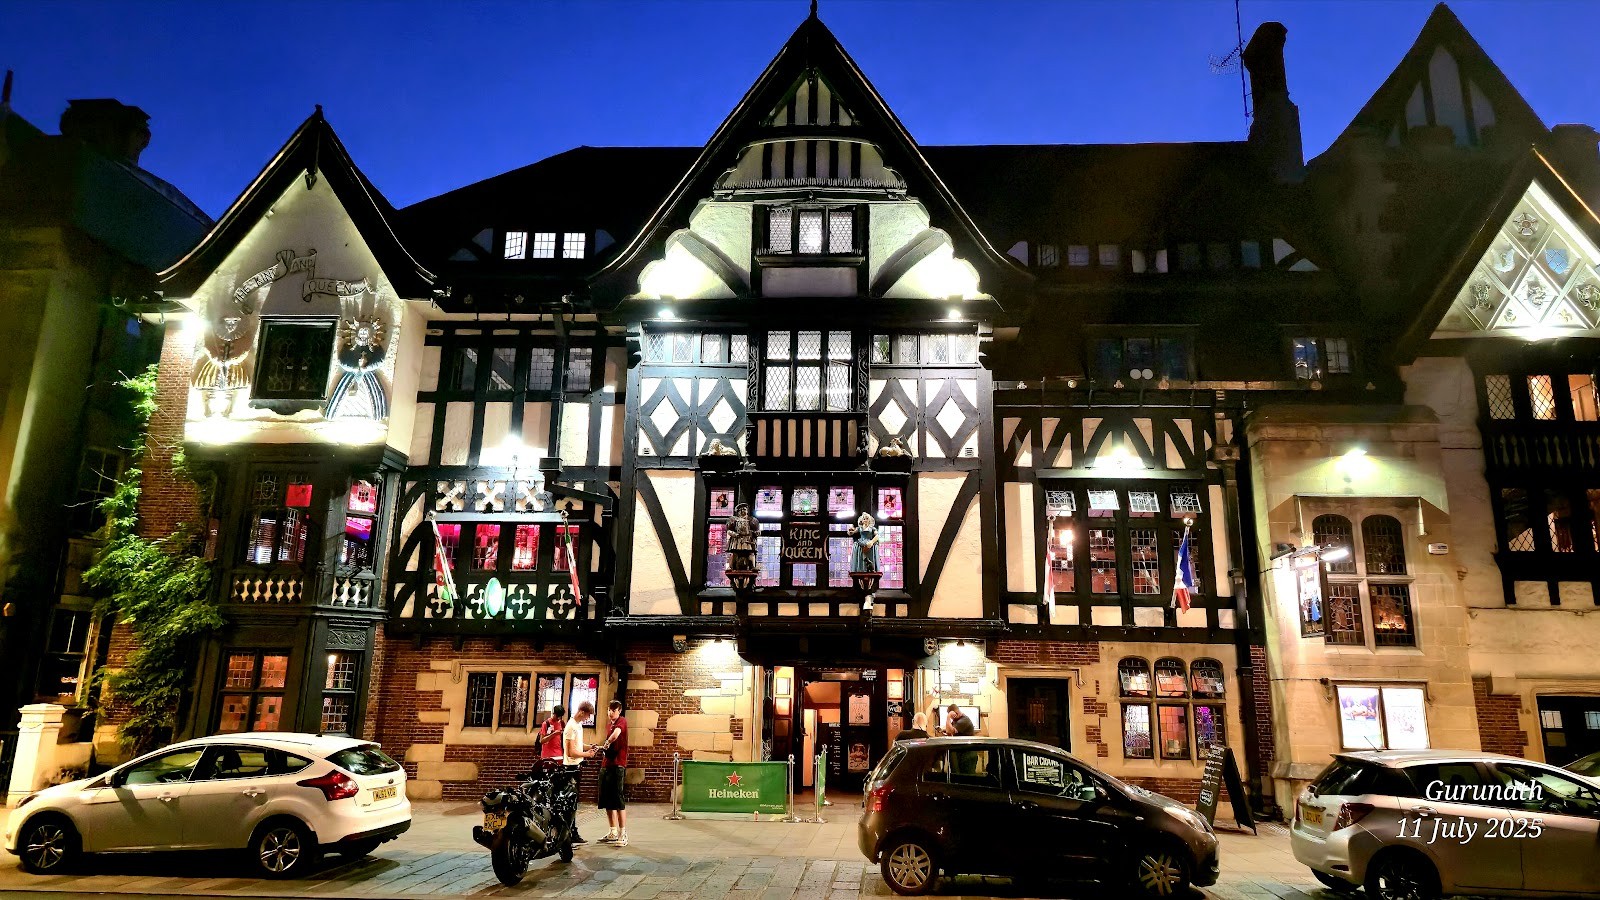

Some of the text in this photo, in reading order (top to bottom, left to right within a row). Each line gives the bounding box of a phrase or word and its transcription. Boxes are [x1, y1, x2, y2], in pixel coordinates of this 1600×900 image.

[292, 260, 314, 273] AND
[309, 280, 352, 294] QUEEN
[789, 528, 820, 540] KING
[785, 546, 823, 559] QUEEN
[1027, 755, 1039, 766] BAR
[709, 788, 759, 799] Heineken
